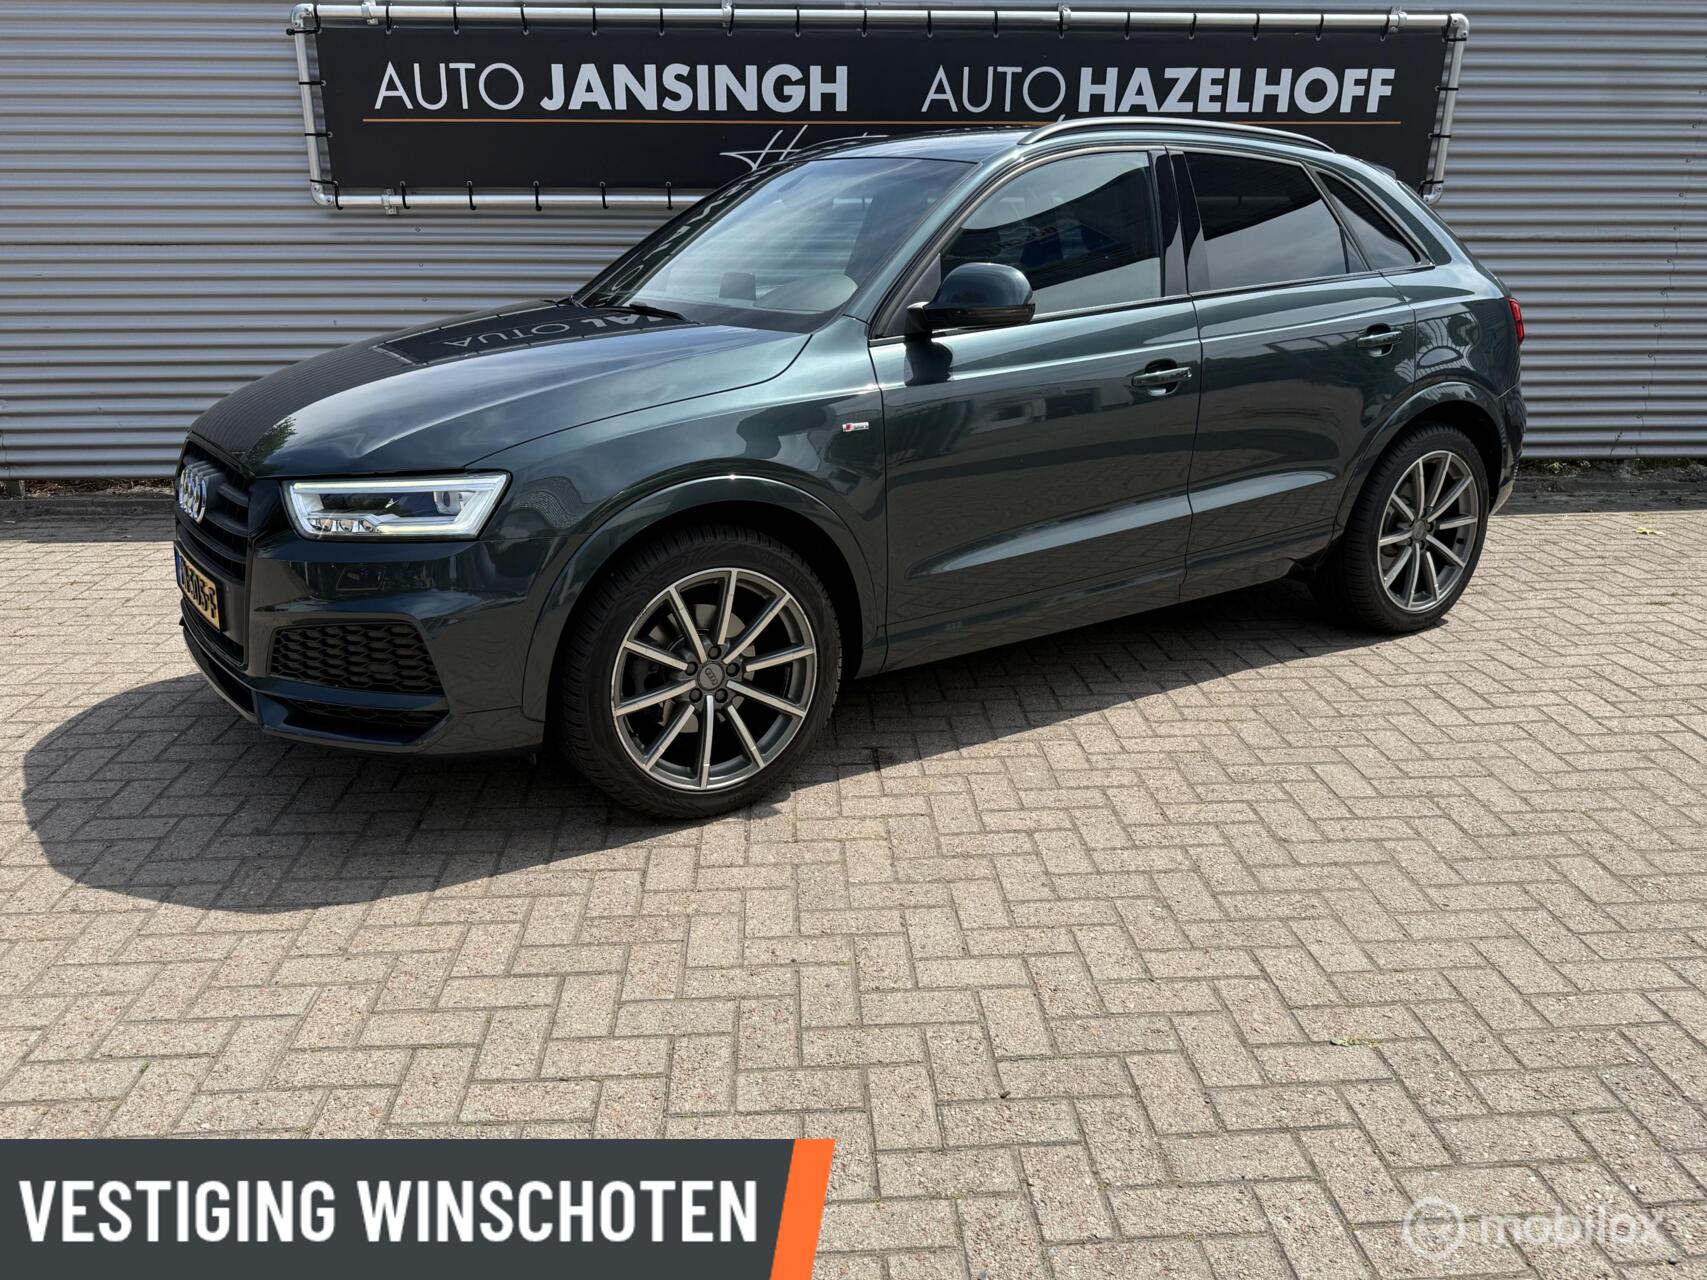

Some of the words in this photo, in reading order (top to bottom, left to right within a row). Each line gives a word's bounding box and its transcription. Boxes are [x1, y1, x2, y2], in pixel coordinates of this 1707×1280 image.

[374, 61, 525, 111] AUTO
[540, 63, 848, 113] JANSINGH
[920, 65, 1066, 113] AUTO
[1078, 66, 1396, 114] HAZELHOFF
